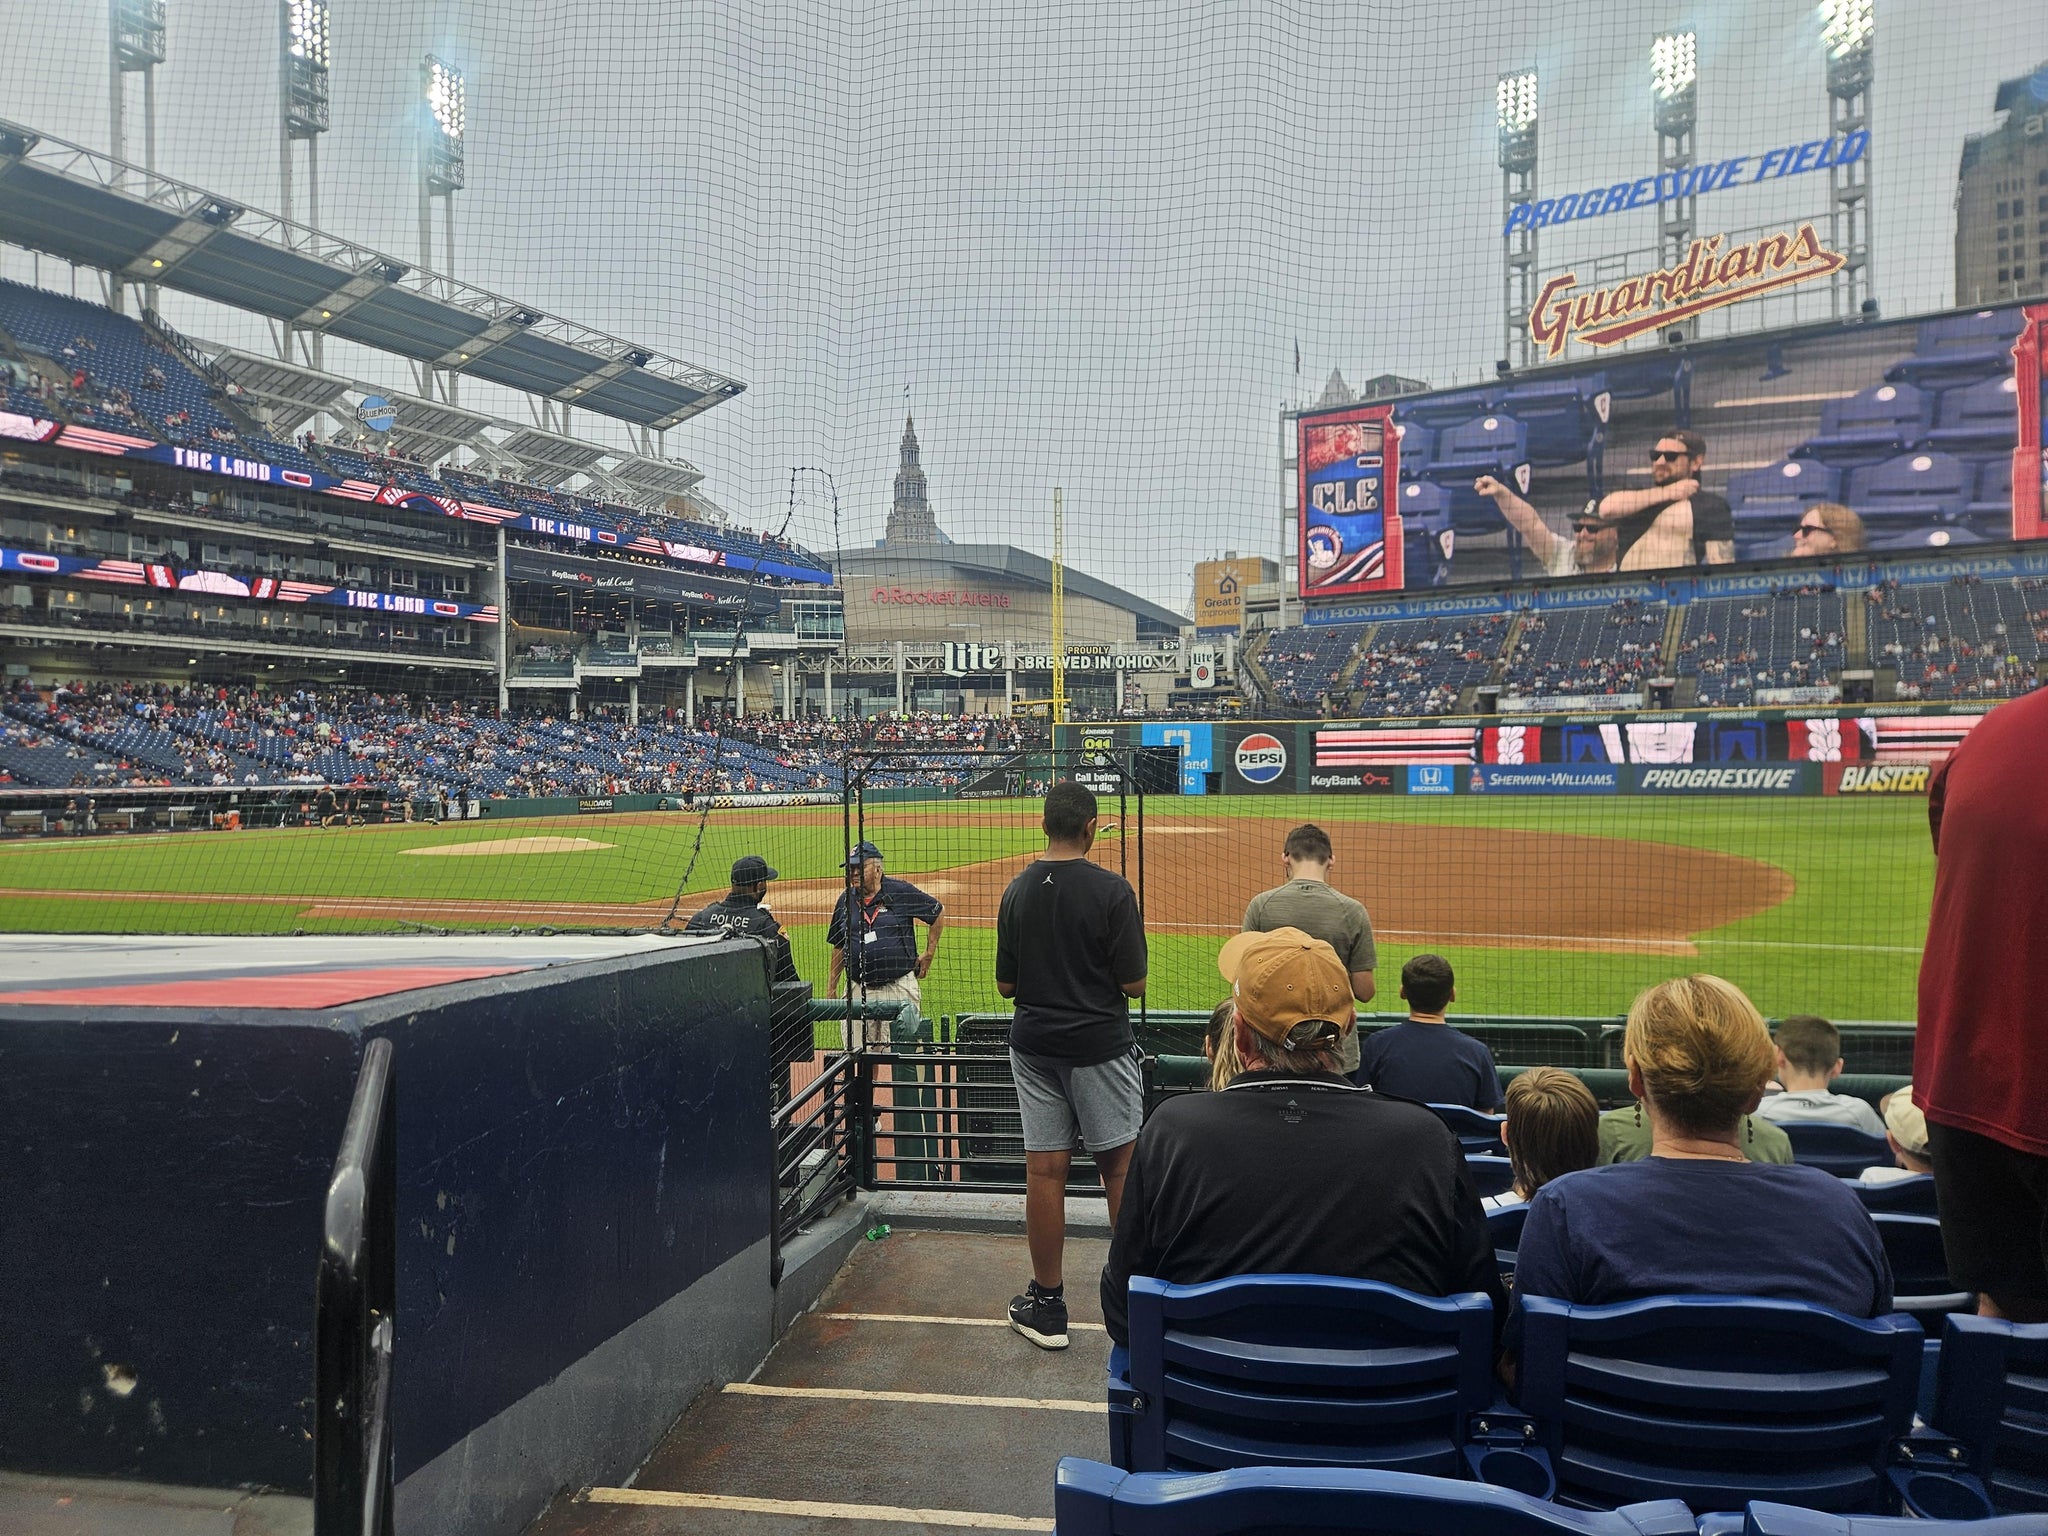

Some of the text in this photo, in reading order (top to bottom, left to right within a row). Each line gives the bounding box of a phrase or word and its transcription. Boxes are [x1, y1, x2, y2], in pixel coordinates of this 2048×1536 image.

[1503, 129, 1872, 237] PROGRESSIVE FIELD
[1528, 222, 1848, 360] Guardians
[359, 405, 397, 420] BLUE MOON
[173, 446, 212, 471] THE
[220, 456, 271, 482] LAND
[1312, 477, 1379, 515] CLE
[530, 516, 555, 534] THE
[559, 522, 591, 541] LAND
[551, 570, 579, 581] KeyBank
[1907, 558, 2016, 578] HONDA
[1728, 572, 1827, 591] HONDA
[681, 590, 704, 599] KeyBank
[890, 587, 1011, 608] Rocket Arena
[1567, 585, 1654, 602] HONDA
[346, 589, 378, 609] THE
[384, 594, 425, 614] LAND
[1204, 599, 1232, 608] Great
[1423, 597, 1503, 612] HONDA
[1328, 604, 1402, 619] HONDA
[1066, 646, 1110, 655] PROUDLY
[1162, 641, 1179, 650] 6:34
[941, 641, 1000, 677] Lite
[1024, 655, 1154, 669] BREWED IN OHIO
[1193, 652, 1213, 665] Lite
[1239, 753, 1283, 764] PEPSI
[1075, 772, 1121, 782] Call before
[1311, 774, 1362, 788] KeyBank
[1641, 768, 1797, 789] PROGRESSIVE
[1839, 766, 1931, 792] BLASTER
[1099, 783, 1115, 793] dig.
[1411, 785, 1451, 793] HONDA
[709, 913, 751, 928] POLICE
